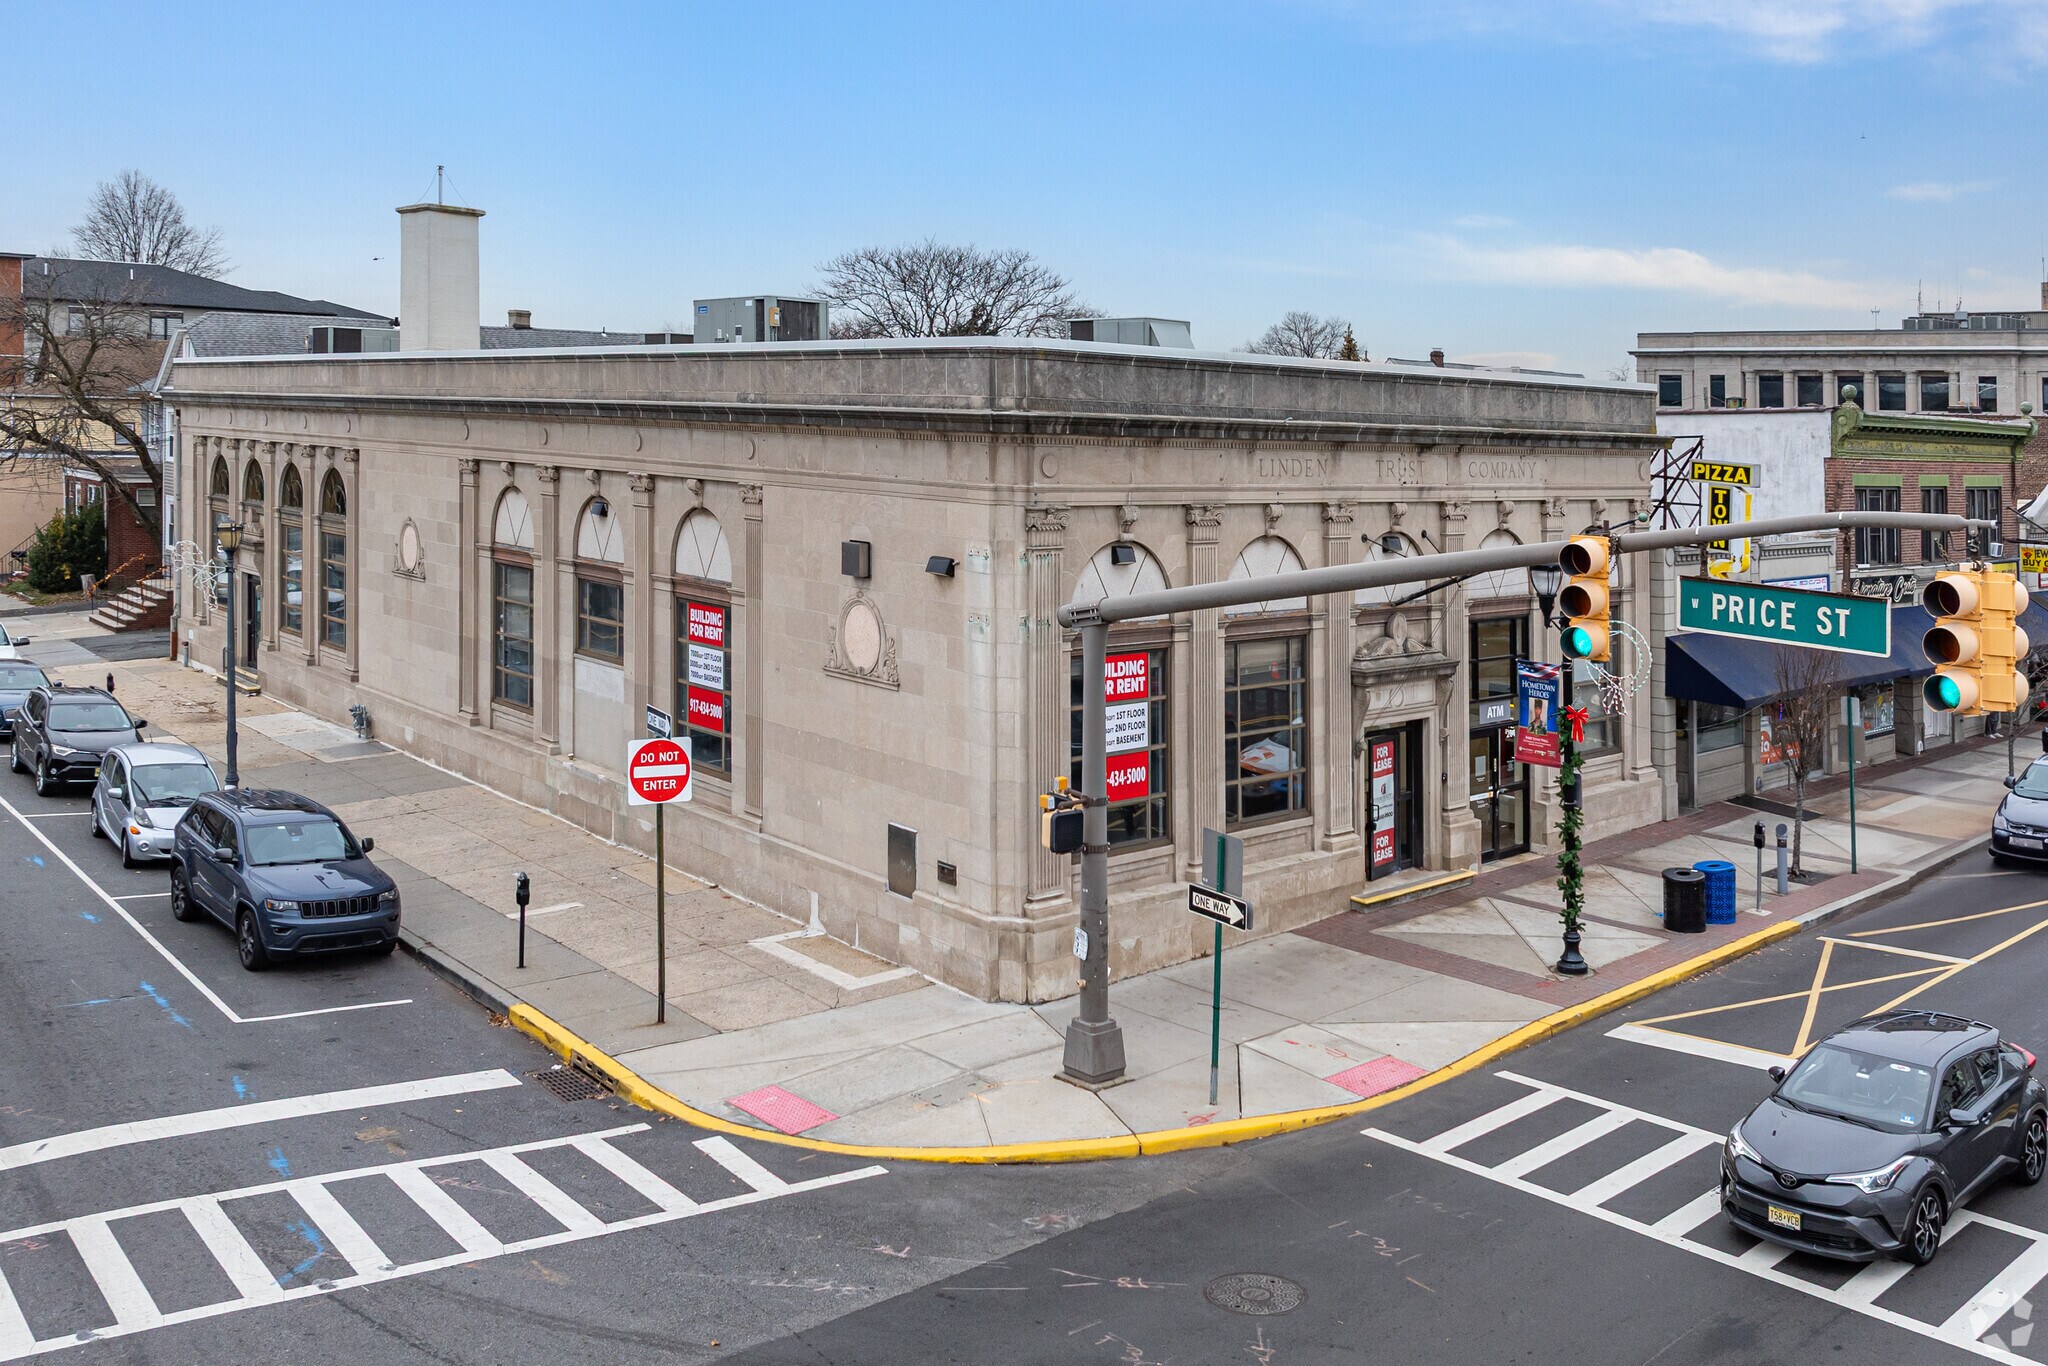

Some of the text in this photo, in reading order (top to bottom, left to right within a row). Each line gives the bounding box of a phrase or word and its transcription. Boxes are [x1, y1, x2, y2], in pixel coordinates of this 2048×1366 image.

[1258, 458, 1537, 479] LINDEN TRUST COMPANY
[1693, 463, 1748, 484] PIZZA
[2022, 559, 2041, 567] BUY
[689, 608, 722, 627] BUILDING
[1691, 591, 1851, 639] W PRICE ST
[689, 622, 723, 642] FOR RENT
[1117, 676, 1146, 694] RENT
[1521, 679, 1556, 692] HOMETOWN
[1528, 688, 1550, 699] HEROES
[689, 698, 723, 719] 917-434-5000
[1116, 711, 1126, 720] 1ST
[1127, 708, 1146, 718] FLOOR
[1487, 704, 1504, 719] ATM
[1115, 722, 1127, 733] 2ND
[1127, 720, 1146, 731] FLOOR
[1116, 732, 1145, 745] BASEMENT
[640, 751, 679, 763] DO NOT
[1376, 746, 1388, 759] FOR
[1373, 757, 1392, 772] LEASE
[1106, 765, 1146, 788] -434-5000
[643, 779, 677, 791] ENTER
[1376, 836, 1389, 849] FOR
[1373, 847, 1393, 862] LEASE
[1194, 894, 1230, 916] ONE WAY
